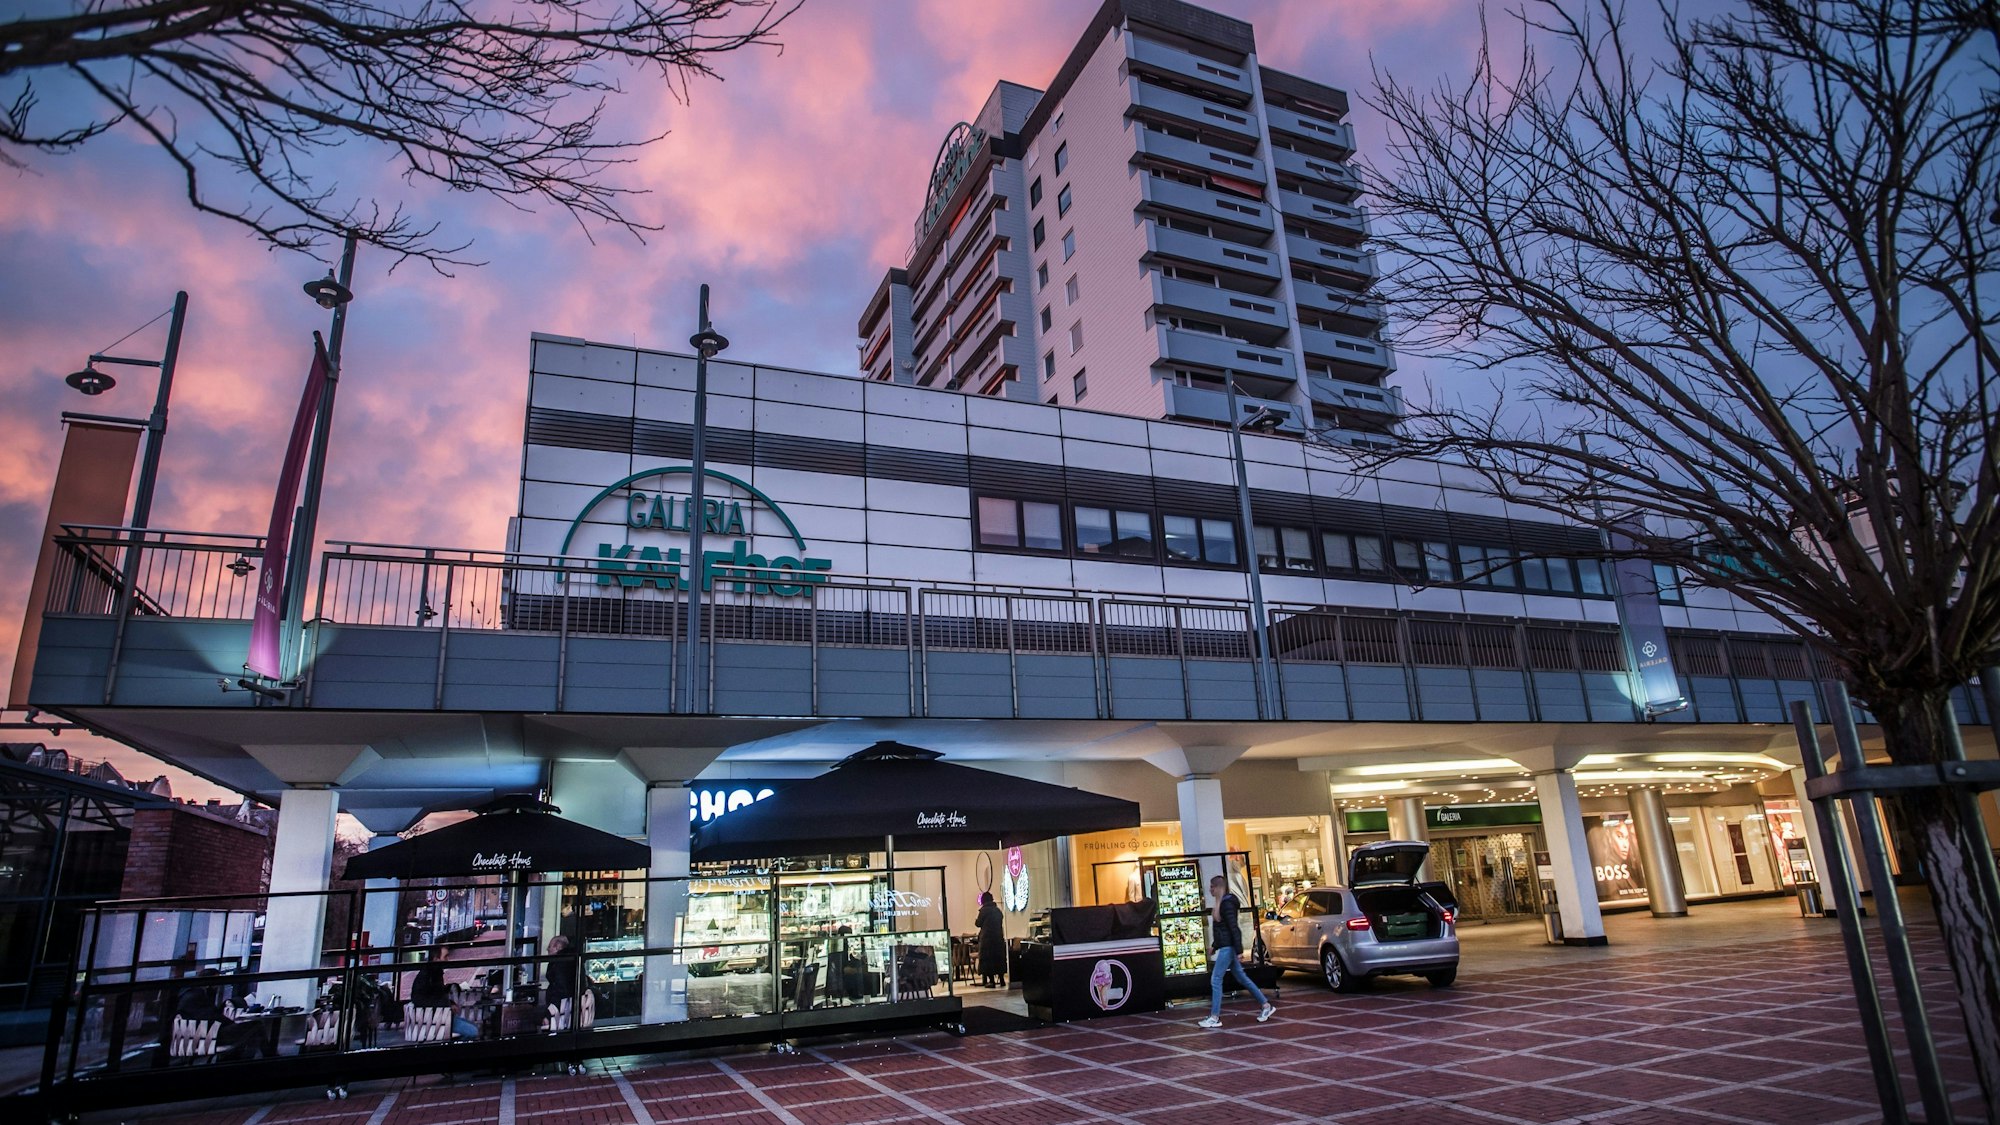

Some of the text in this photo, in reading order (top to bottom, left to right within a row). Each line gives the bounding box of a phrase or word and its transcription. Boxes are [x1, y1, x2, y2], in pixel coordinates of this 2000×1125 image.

[626, 492, 746, 536] GALERIA
[690, 788, 775, 822] HO
[1440, 812, 1462, 822] GALERIA
[1084, 839, 1180, 850] FRÜHLING GALERIA
[1594, 863, 1631, 882] BOSS
